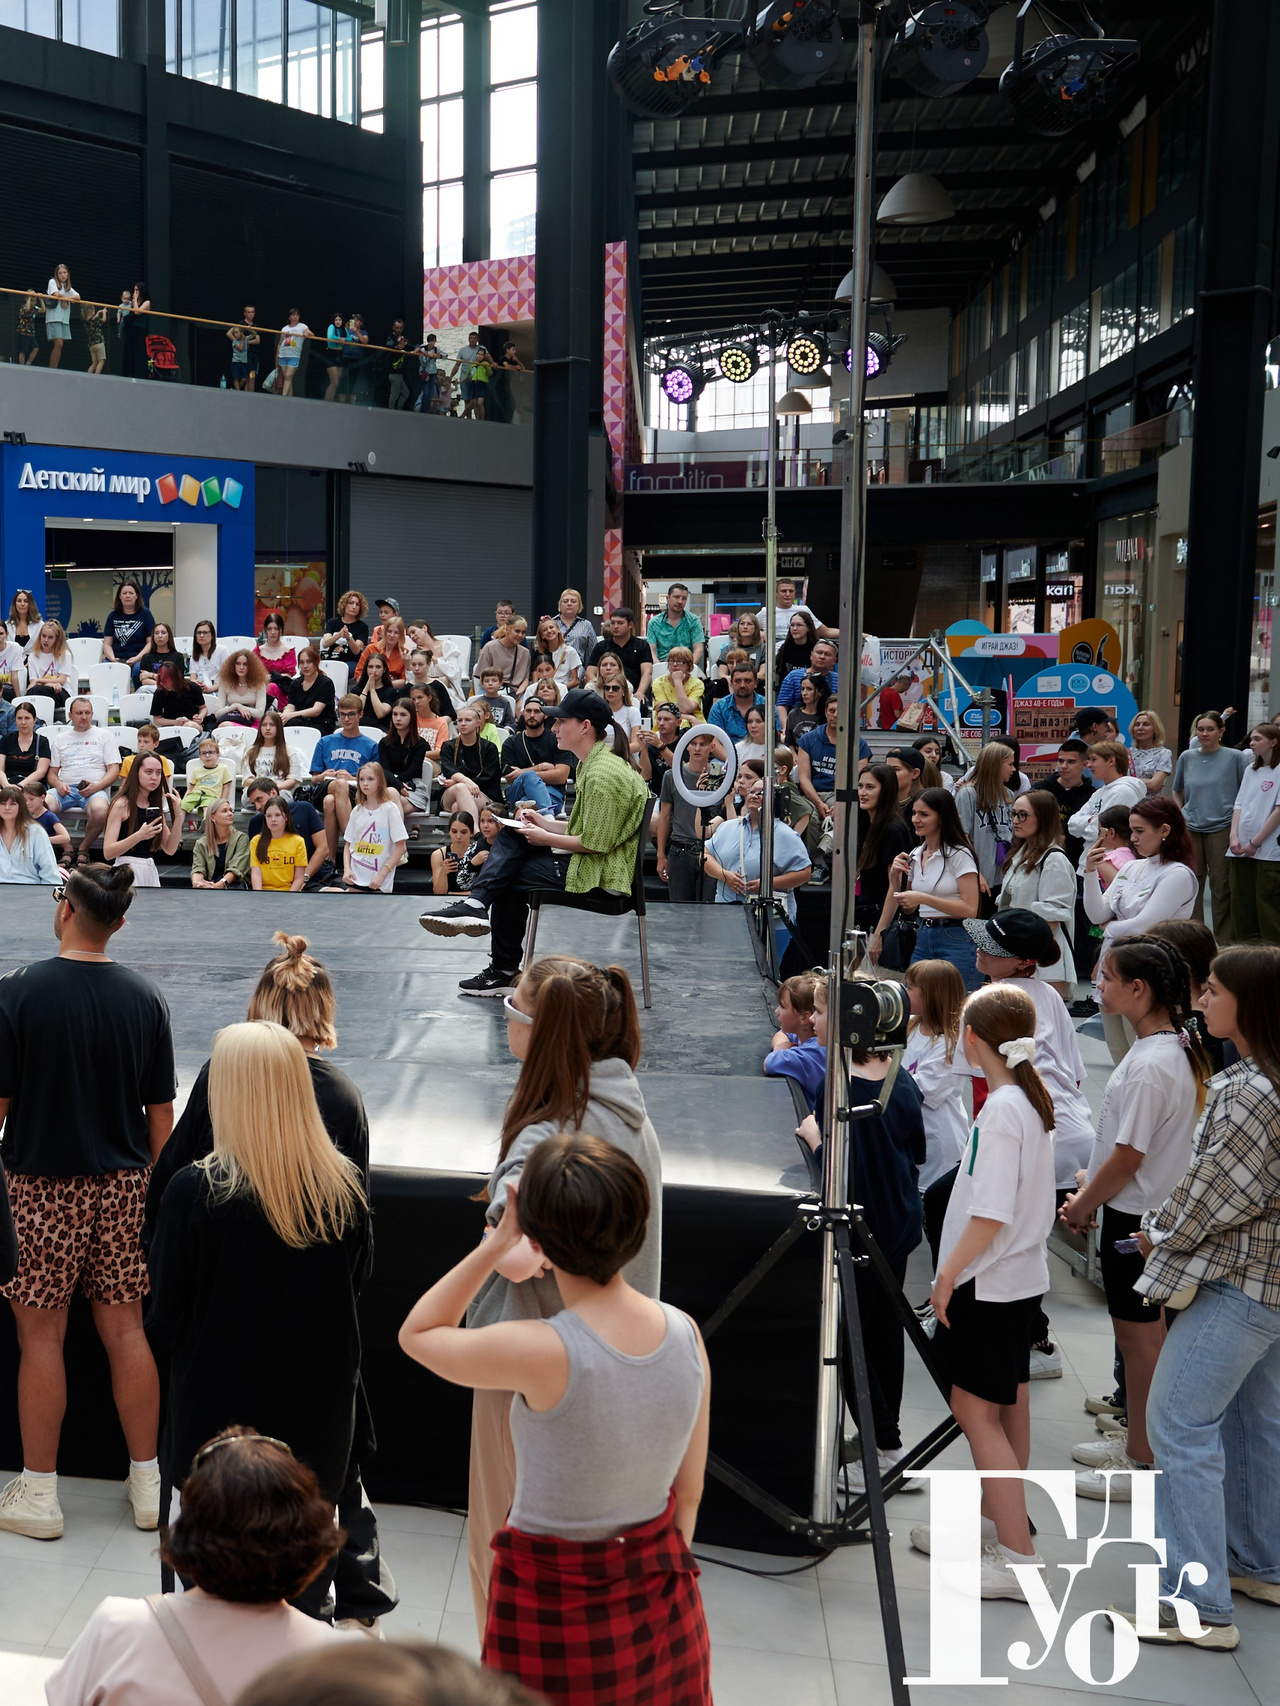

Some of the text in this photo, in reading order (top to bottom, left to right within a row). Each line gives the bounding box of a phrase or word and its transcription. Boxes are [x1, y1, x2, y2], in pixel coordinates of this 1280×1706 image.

[18, 462, 150, 503] Детский мир
[1046, 584, 1074, 596] kari
[981, 641, 1019, 651] ИГРАЙ ДЖАЗ!
[975, 804, 1013, 832] YAL
